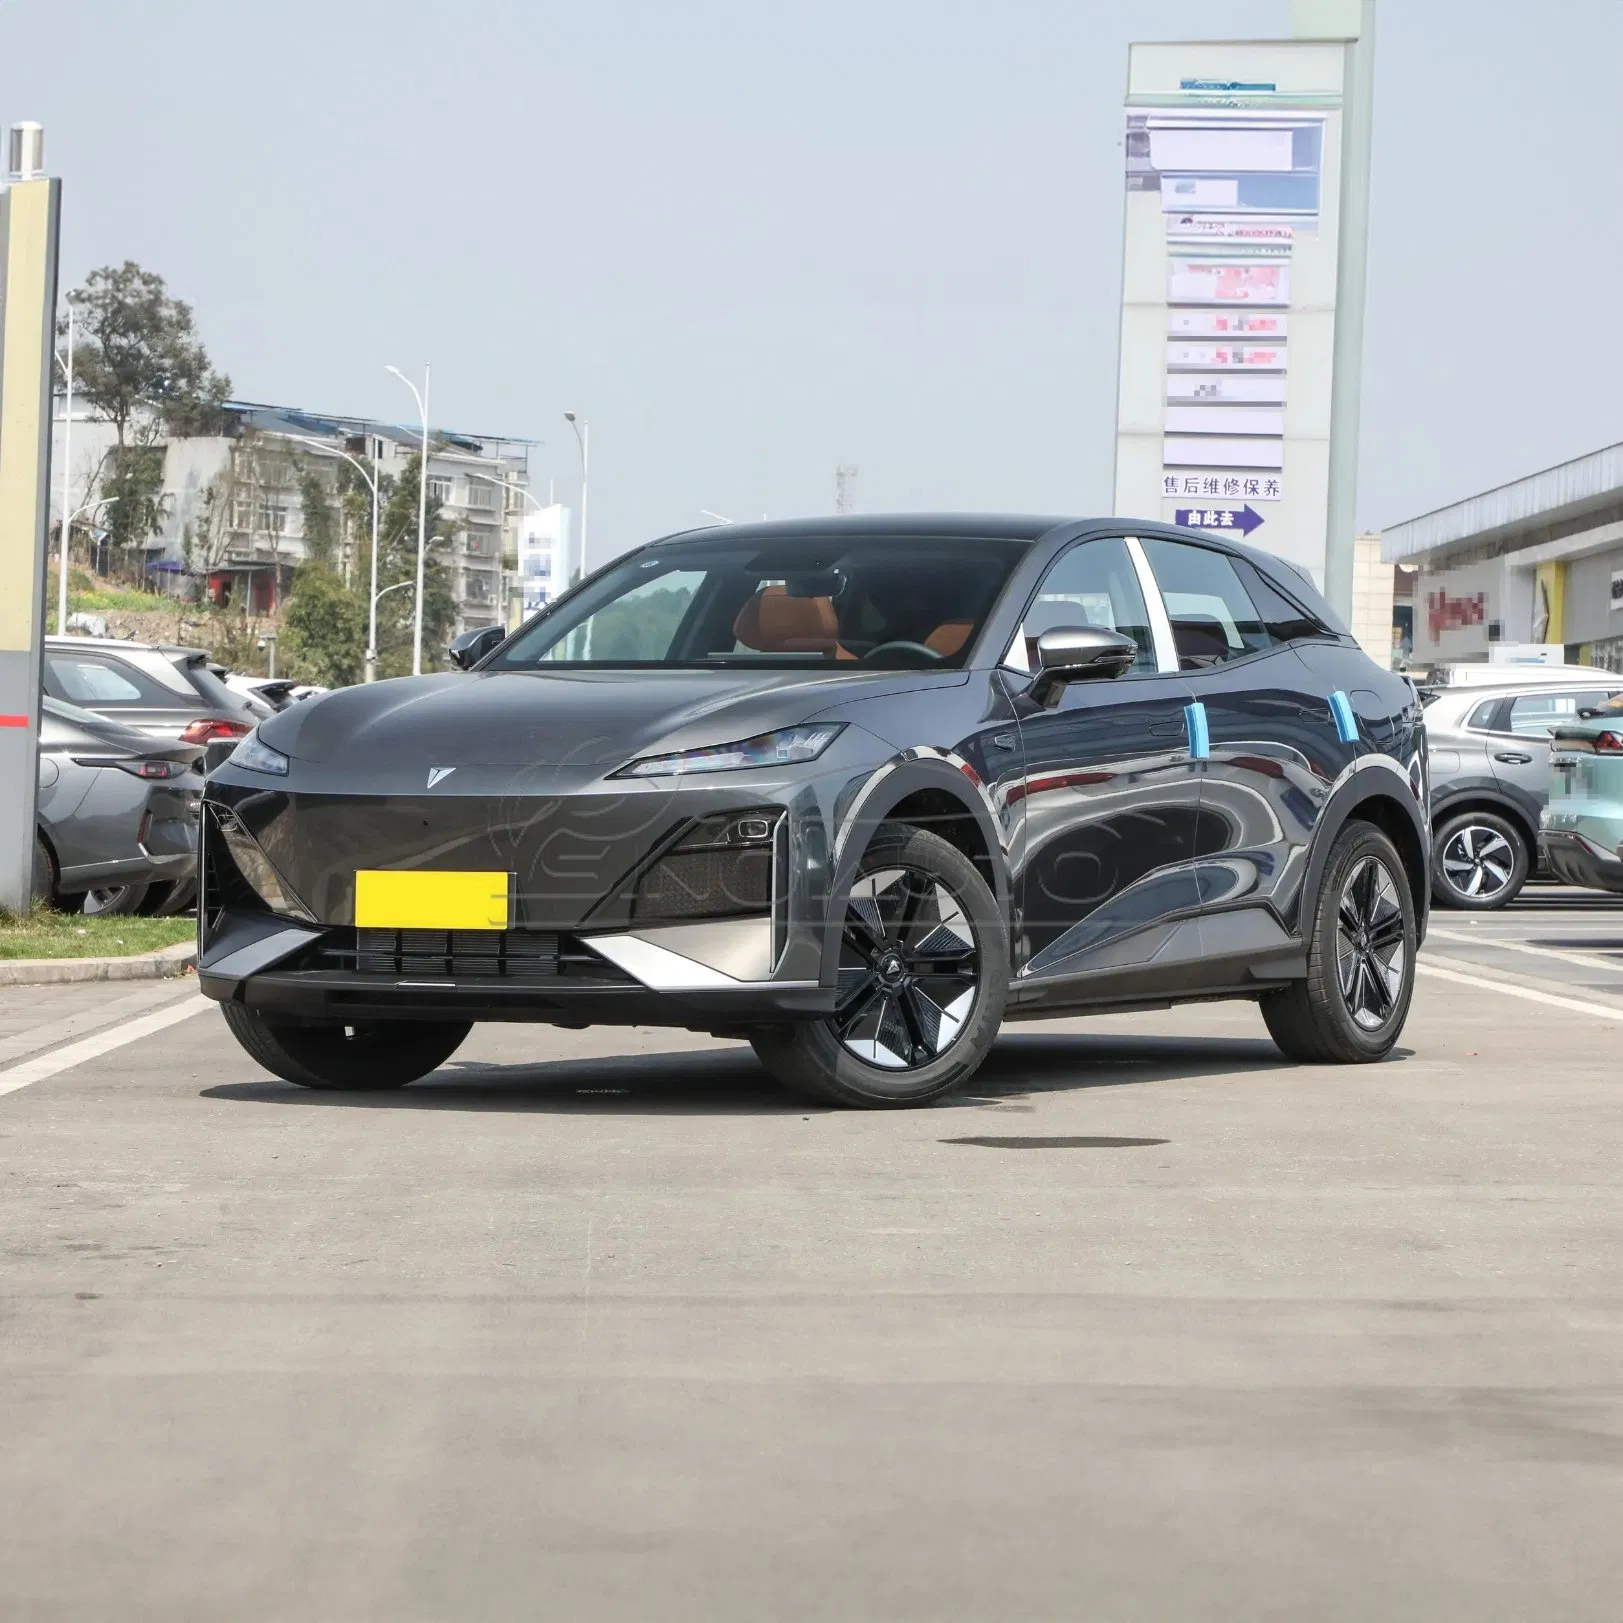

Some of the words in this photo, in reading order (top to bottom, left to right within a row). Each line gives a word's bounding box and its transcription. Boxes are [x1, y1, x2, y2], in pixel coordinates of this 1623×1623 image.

[1163, 476, 1280, 496] 售后维修保养
[1187, 510, 1235, 526] 由此去
